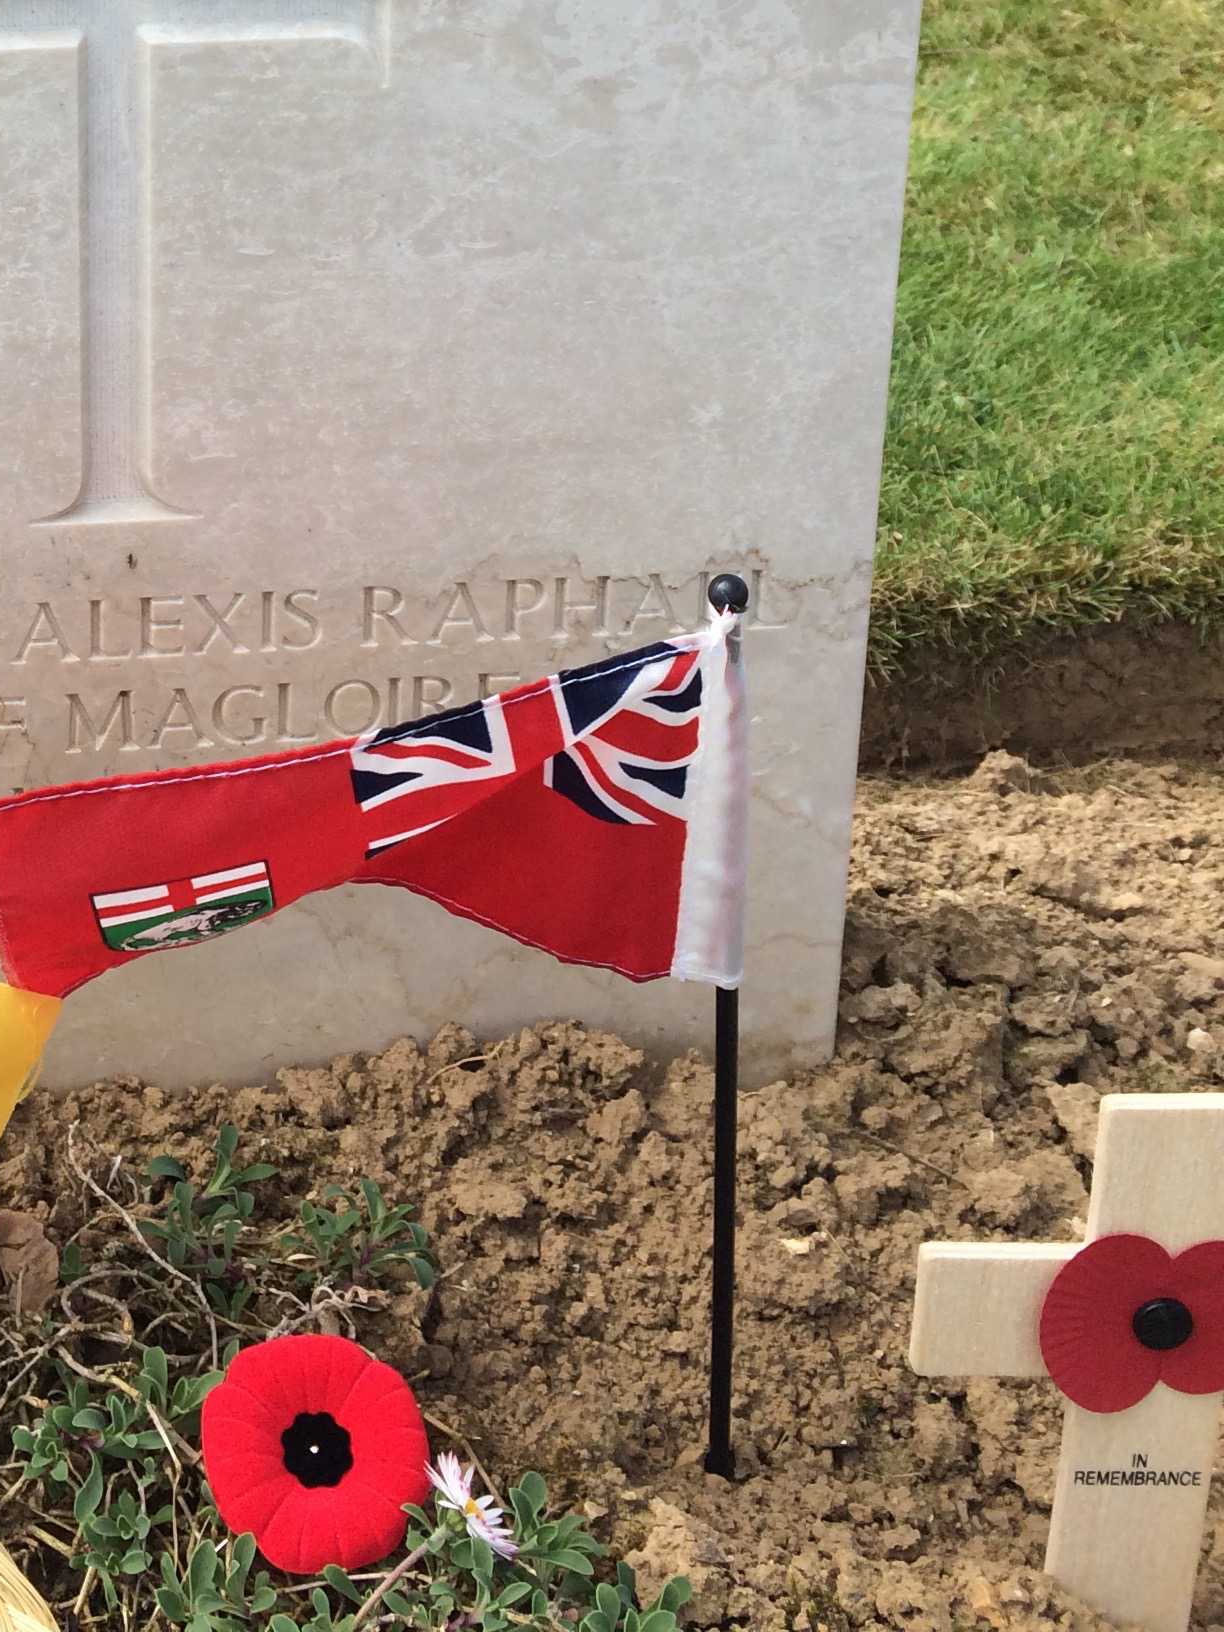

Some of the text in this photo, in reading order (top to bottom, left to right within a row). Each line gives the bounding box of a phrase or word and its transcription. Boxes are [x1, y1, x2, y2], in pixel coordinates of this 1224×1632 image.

[11, 587, 324, 665] ALEXIS
[1131, 1454, 1148, 1468] IN
[1074, 1471, 1201, 1486] REMEMBRANCE
